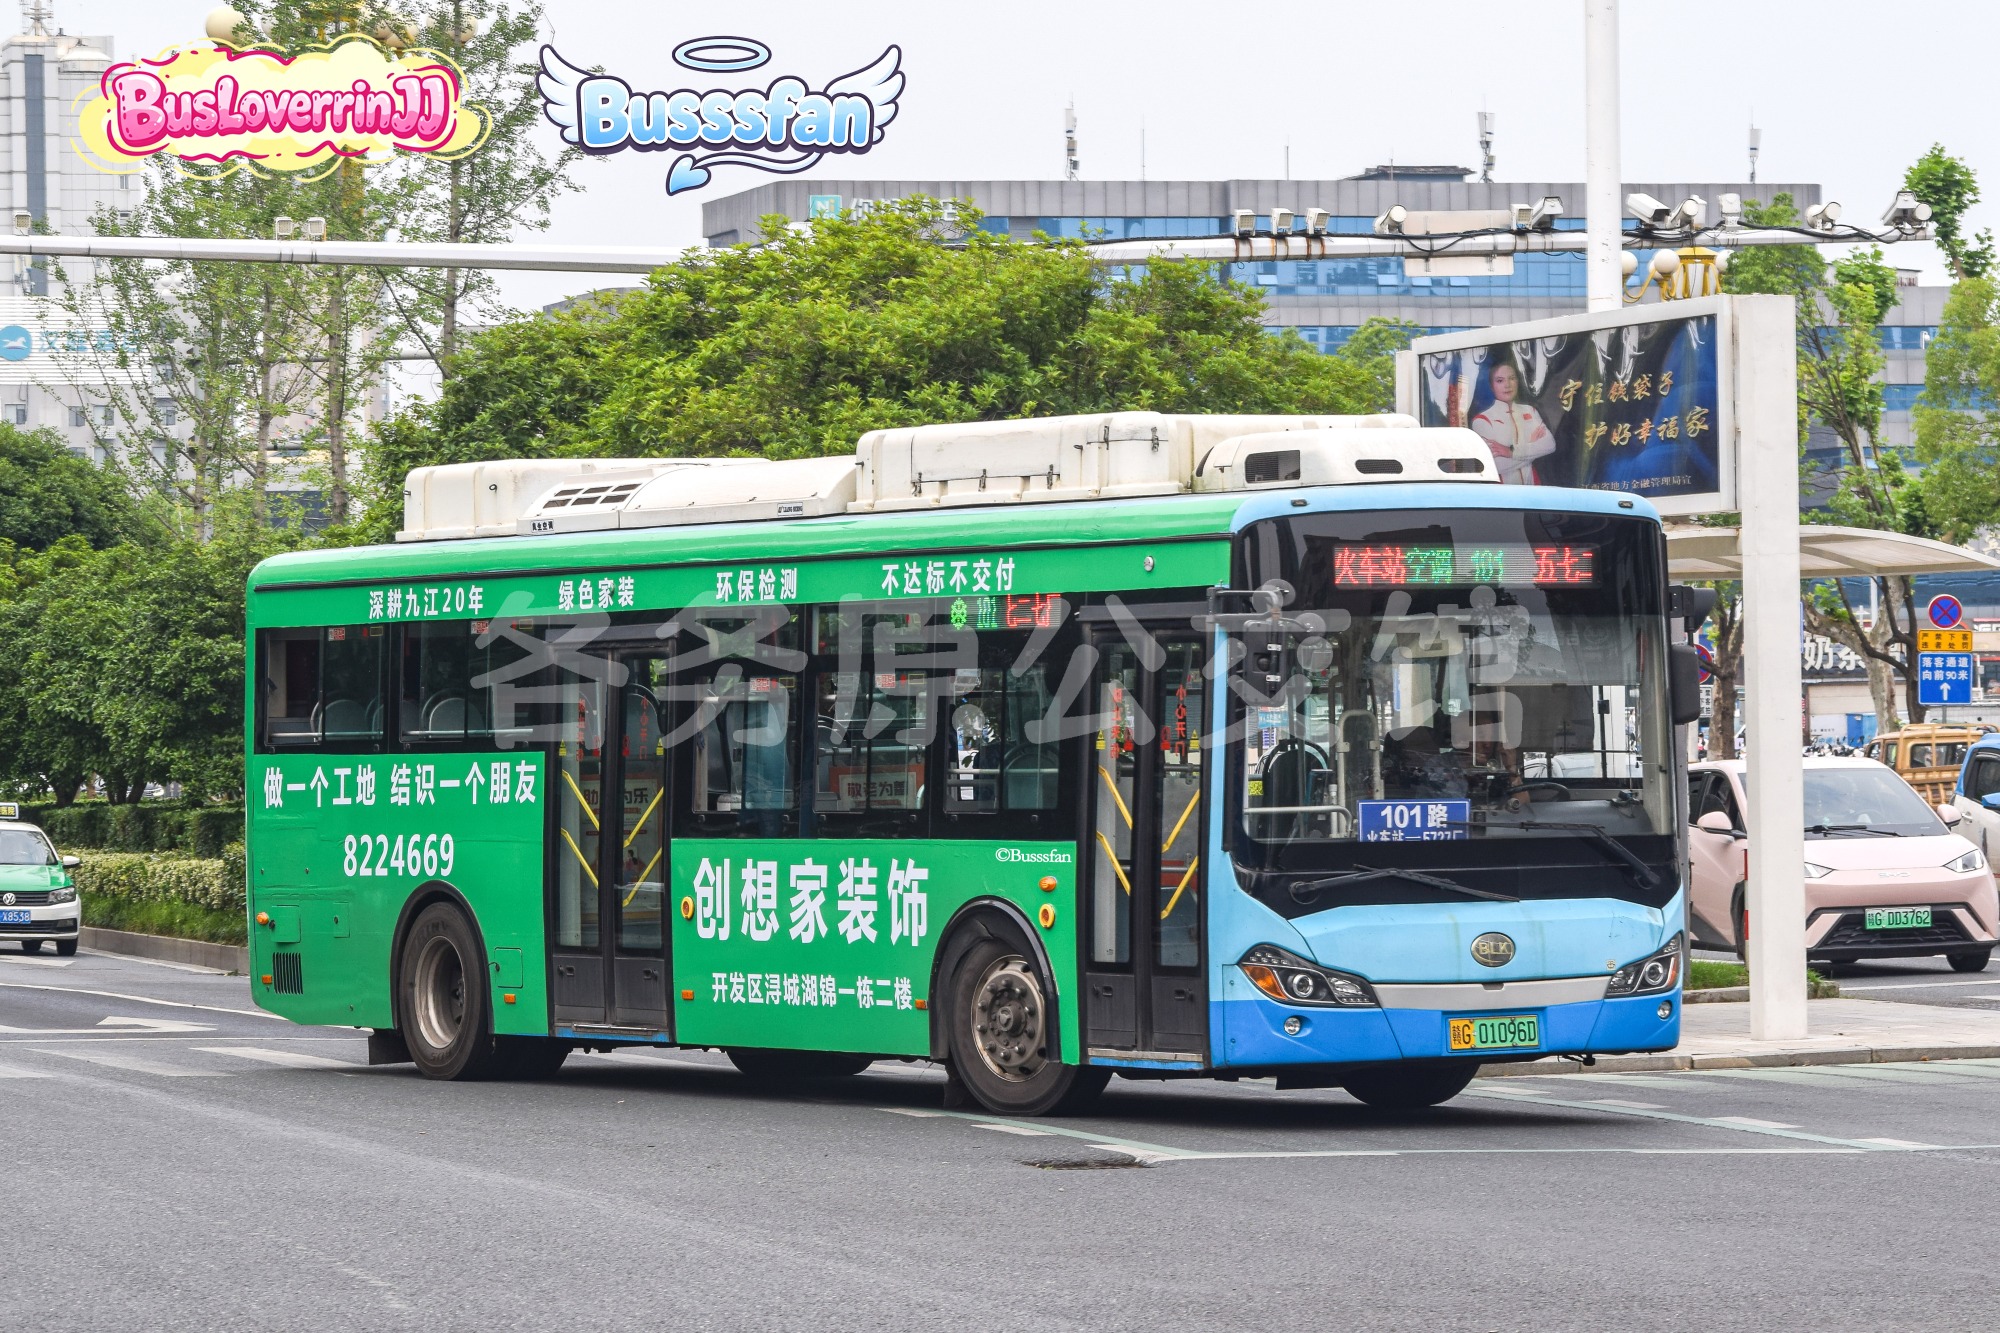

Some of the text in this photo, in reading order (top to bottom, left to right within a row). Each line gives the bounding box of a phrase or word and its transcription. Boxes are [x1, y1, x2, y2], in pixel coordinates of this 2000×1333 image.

[1559, 371, 1674, 412] 守住钱袋子
[1584, 406, 1710, 449] 护好幸福家
[558, 575, 635, 611] 绿色家装
[715, 566, 799, 606] 环保检测
[881, 556, 1016, 597] 不达标不交付
[368, 584, 485, 622] 深耕九江20年
[1922, 657, 1969, 668] 落客通道
[1922, 670, 1969, 681] 向前90米
[263, 760, 537, 809] 做一个工地 结识一个朋友
[343, 833, 454, 877] 8224669
[693, 857, 929, 948] 创想家装饰
[711, 971, 913, 1010] 开发区浔城湖锦一栋二楼
